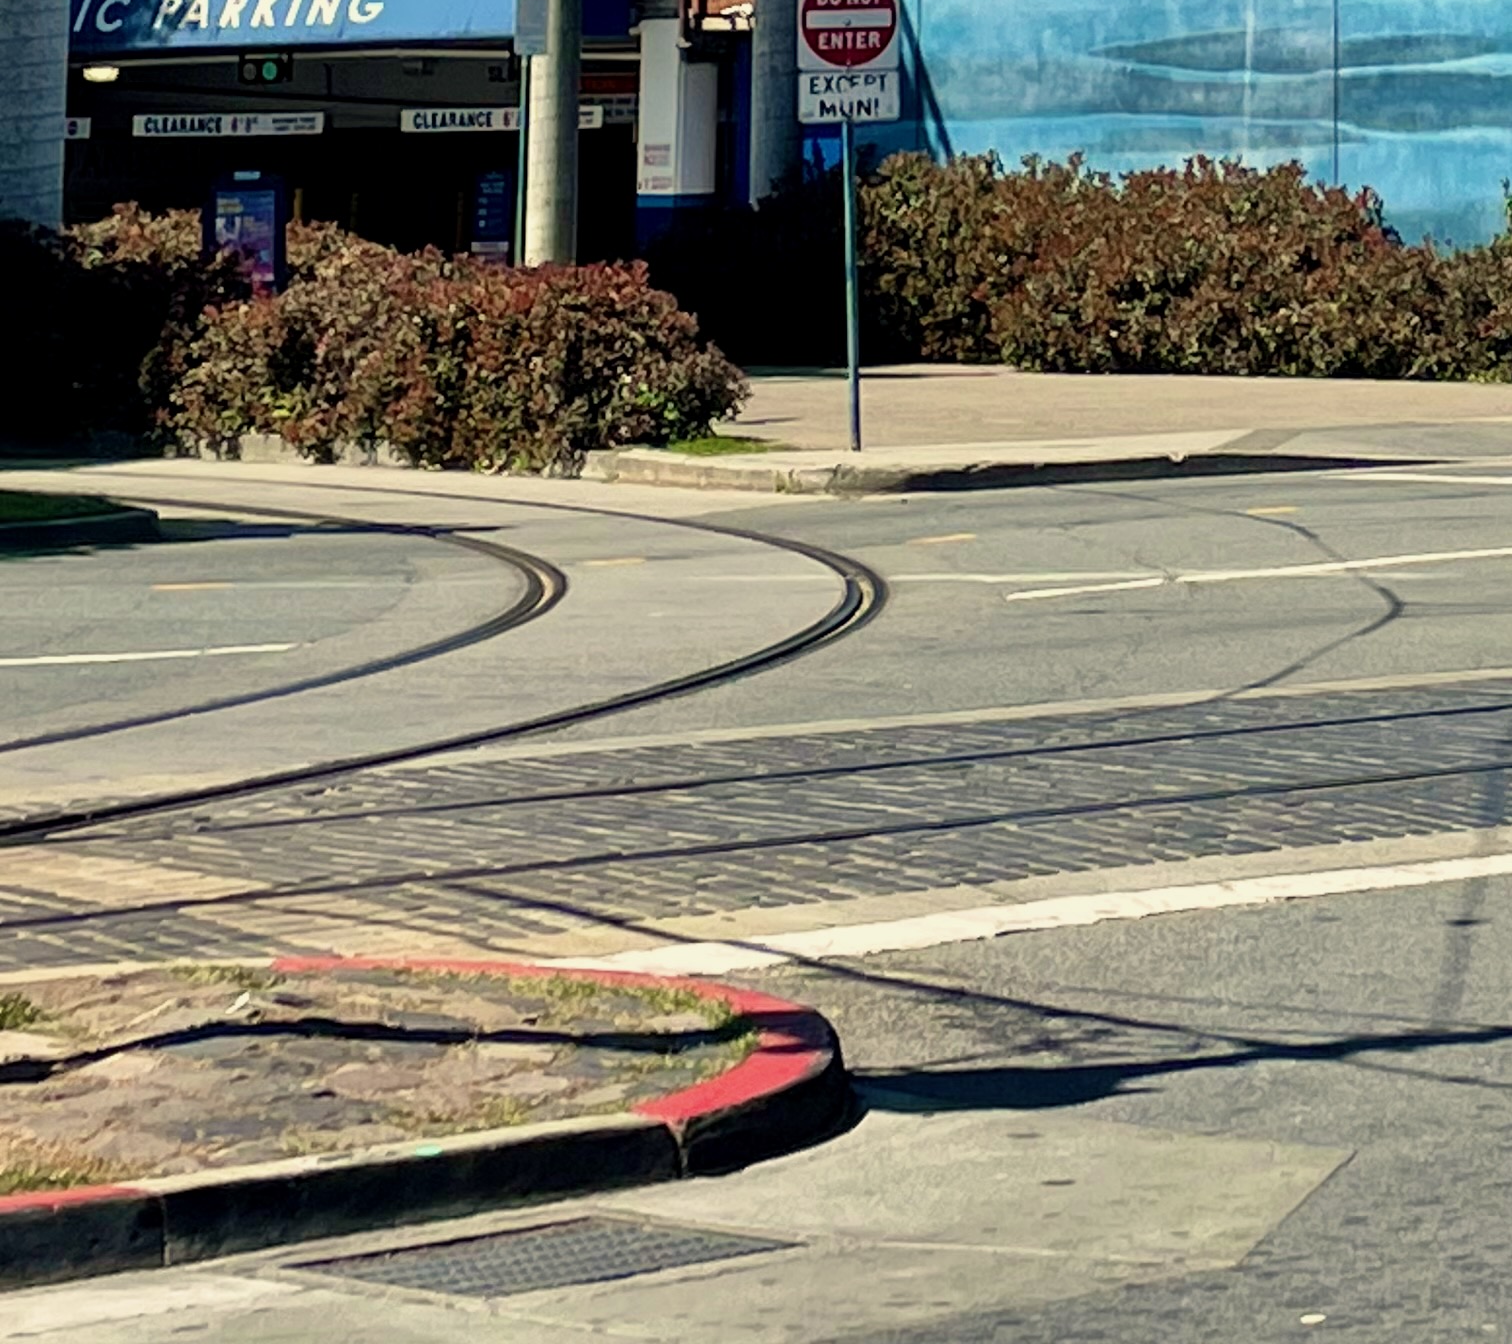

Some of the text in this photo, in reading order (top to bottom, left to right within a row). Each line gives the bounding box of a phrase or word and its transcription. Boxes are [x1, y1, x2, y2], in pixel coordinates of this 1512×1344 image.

[818, 31, 881, 50] ENTER
[809, 74, 888, 95] EXCEPT
[819, 98, 879, 118] MUNI
[413, 110, 493, 130] CLEARANCE
